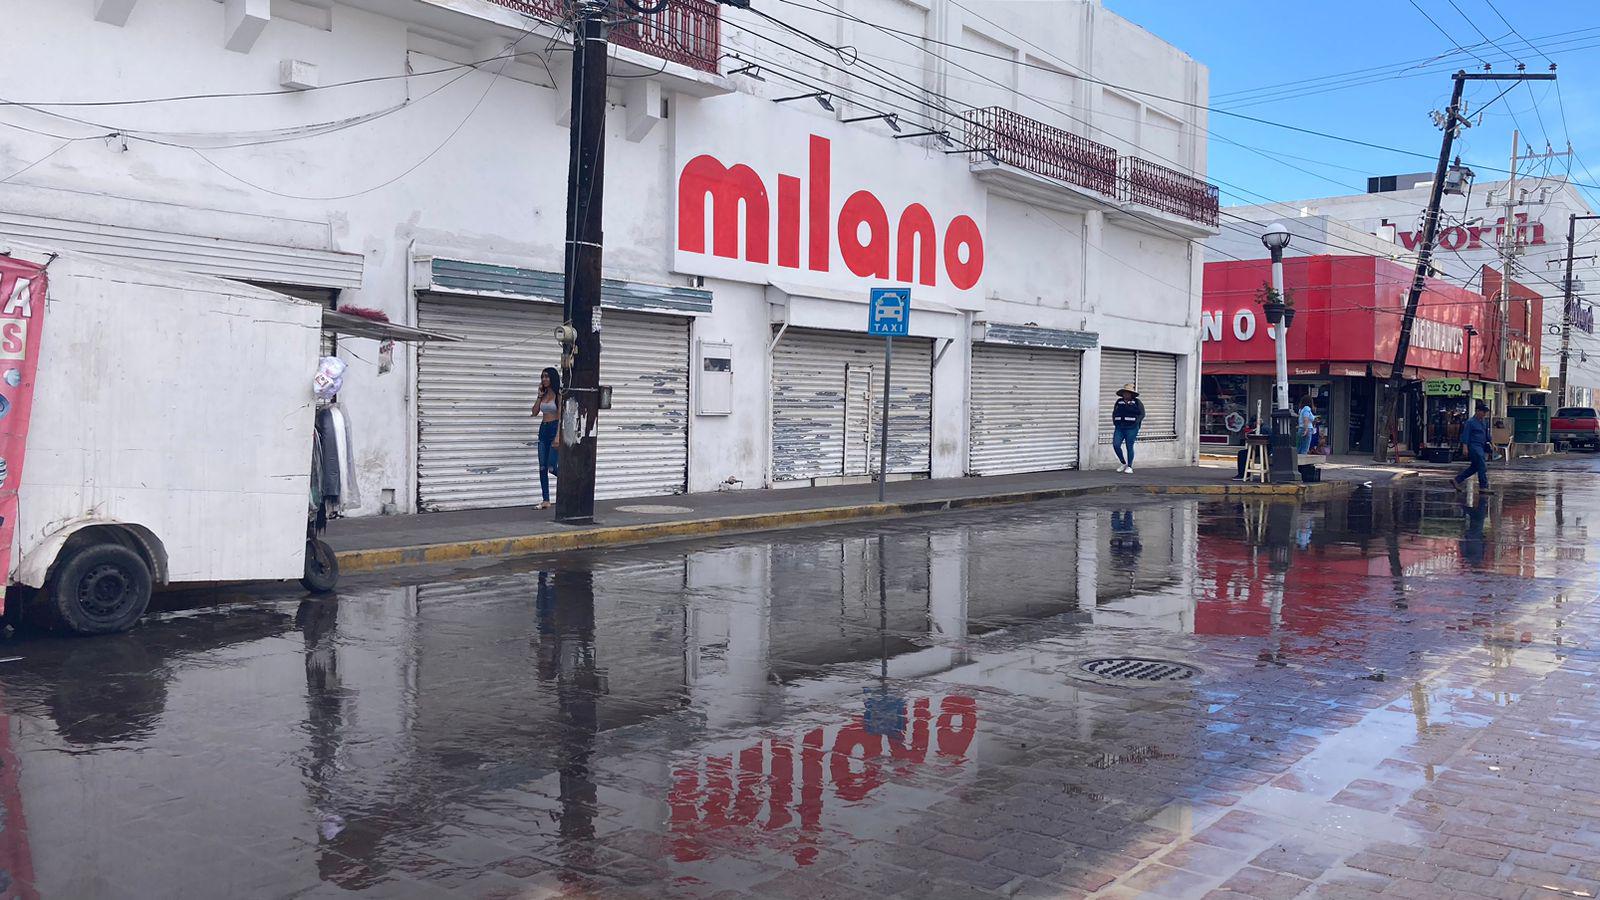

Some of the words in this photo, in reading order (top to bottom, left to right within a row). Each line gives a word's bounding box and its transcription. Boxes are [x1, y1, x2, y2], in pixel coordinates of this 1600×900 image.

[678, 133, 984, 291] milano
[873, 323, 903, 332] TAXI
[1441, 383, 1461, 393] $70
